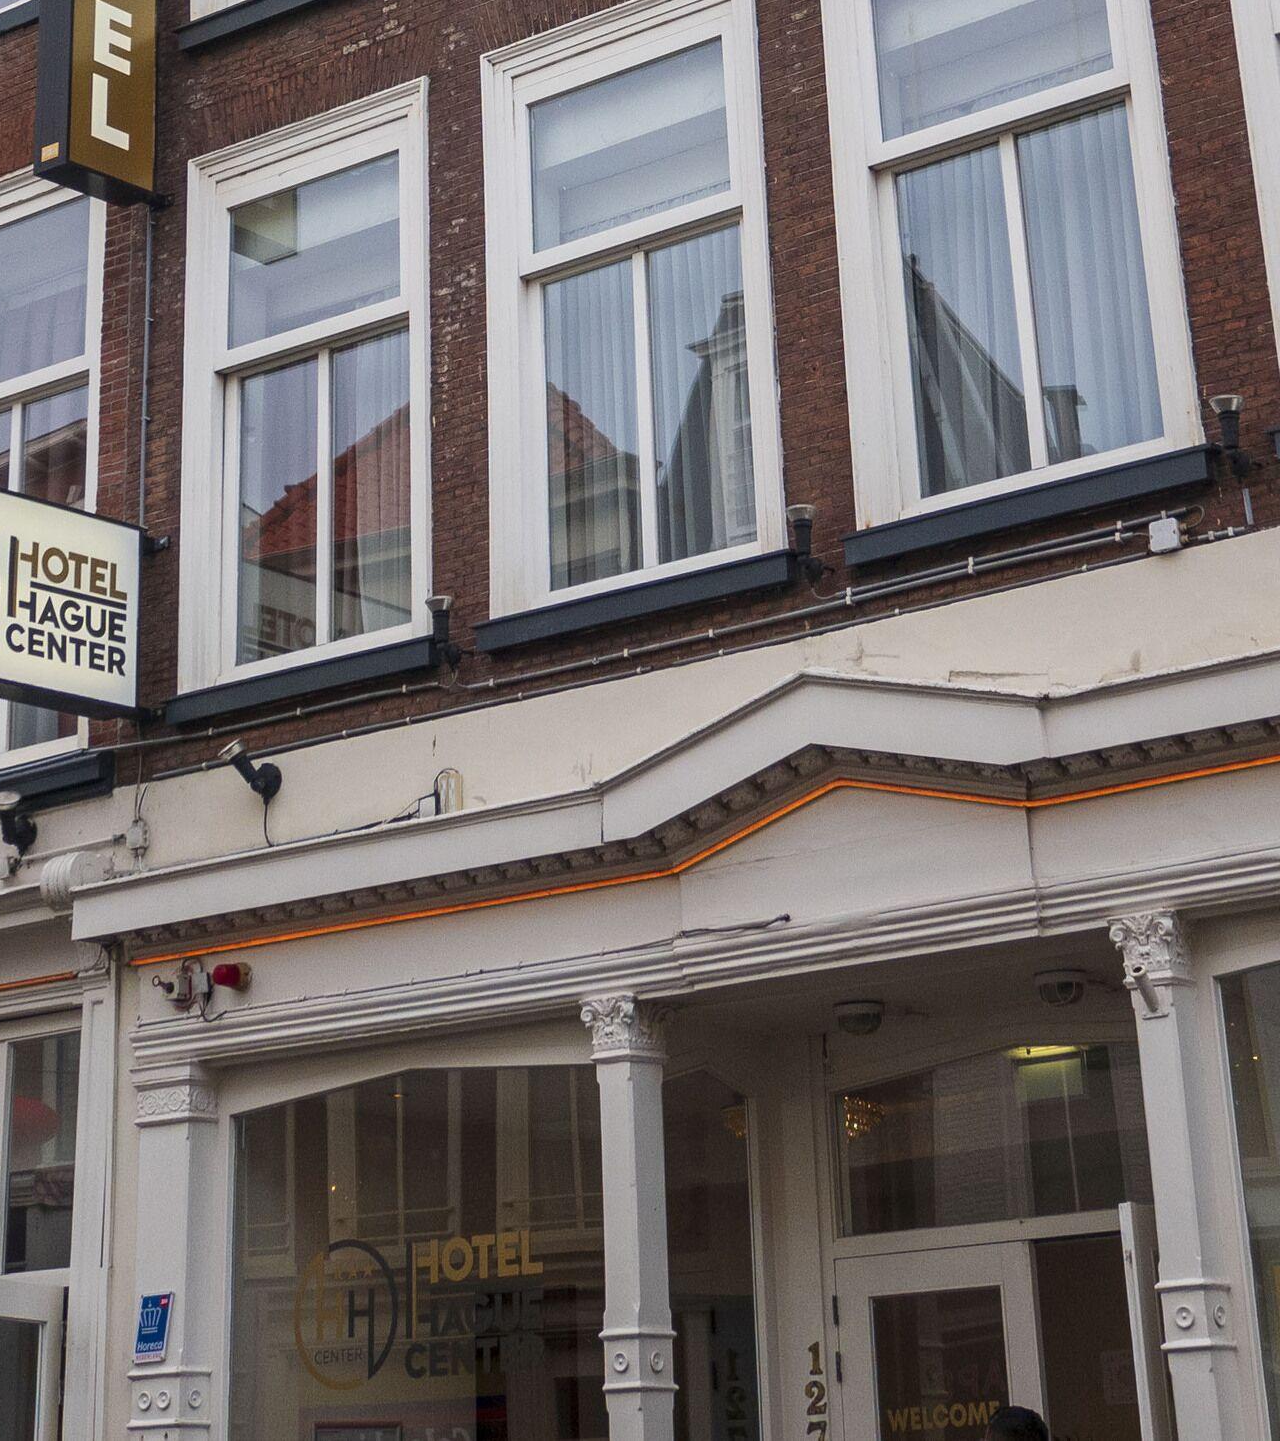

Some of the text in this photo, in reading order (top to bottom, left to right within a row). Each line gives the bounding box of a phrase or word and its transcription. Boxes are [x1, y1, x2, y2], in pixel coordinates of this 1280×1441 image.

[7, 536, 128, 601] HOTEL
[7, 588, 127, 644] HAGUE
[5, 623, 126, 677] CENTER
[410, 1229, 544, 1284] HOTEL
[138, 1341, 163, 1354] Horeca
[314, 1348, 364, 1366] CENTER
